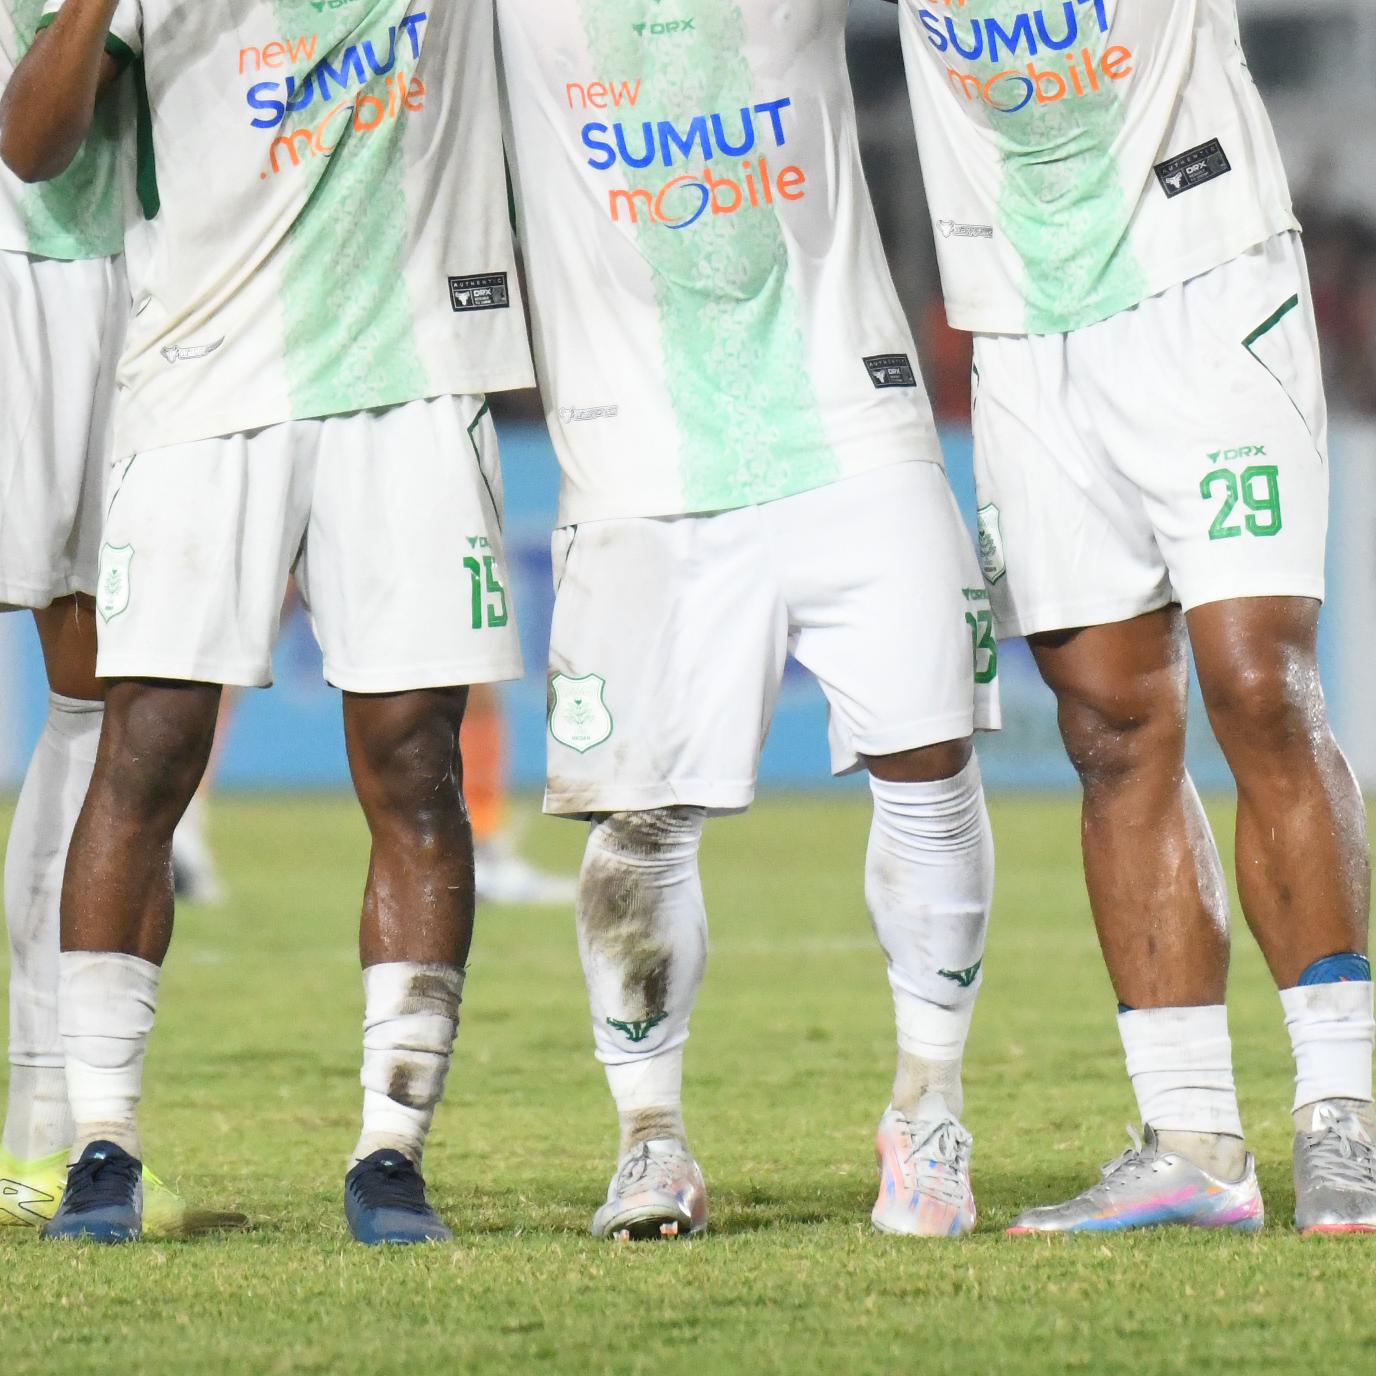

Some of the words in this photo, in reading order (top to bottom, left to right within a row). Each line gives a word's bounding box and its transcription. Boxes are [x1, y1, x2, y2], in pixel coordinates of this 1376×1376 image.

[239, 35, 317, 74] new
[246, 12, 427, 129] SUMUT
[947, 44, 1132, 113] mobile
[566, 79, 641, 109] new
[581, 97, 791, 170] SUMUT
[609, 152, 806, 230] mobile
[1224, 445, 1267, 461] DRX
[1200, 465, 1282, 541] 29
[463, 555, 508, 629] 15
